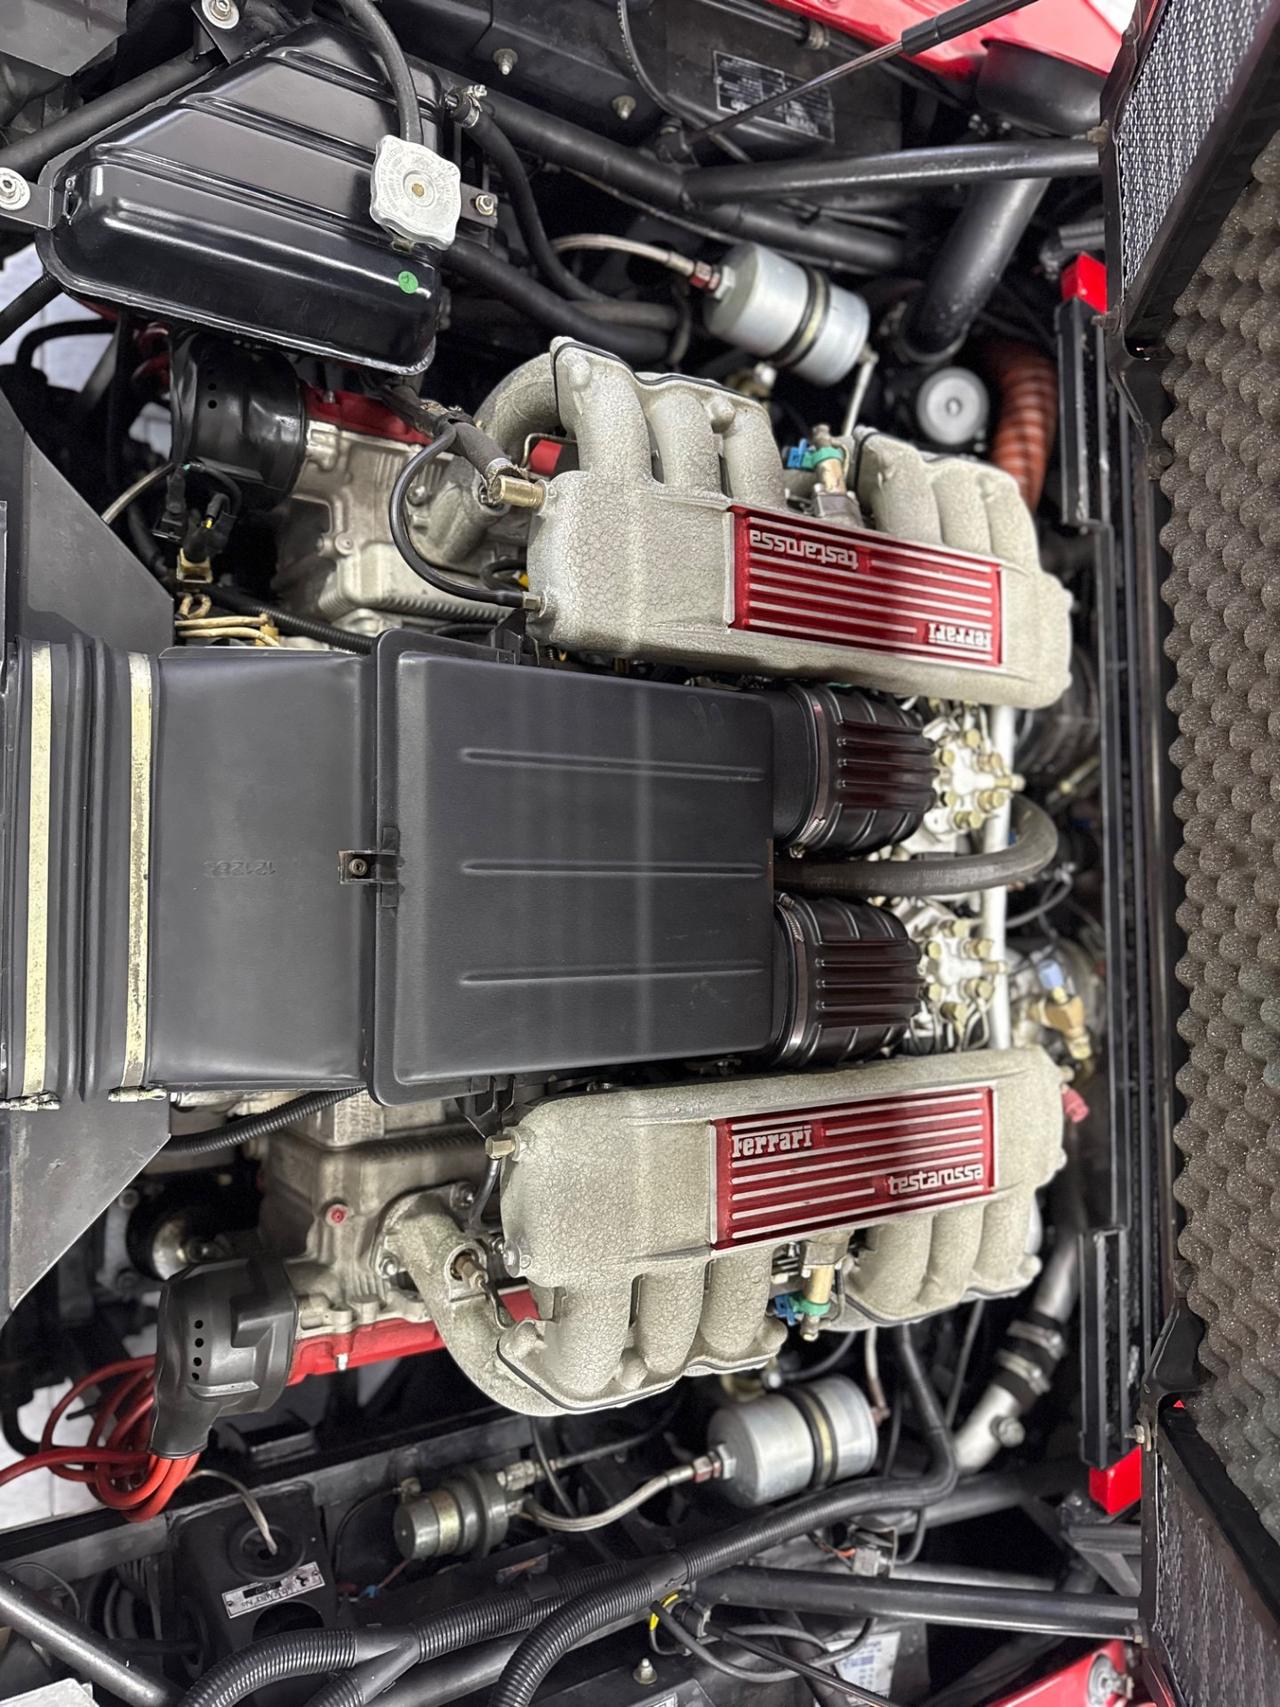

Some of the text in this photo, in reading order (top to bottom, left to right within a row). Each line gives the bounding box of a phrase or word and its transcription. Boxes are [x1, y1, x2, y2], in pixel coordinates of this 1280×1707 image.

[749, 529, 859, 570] testarossa
[928, 623, 992, 652] Ferrari
[731, 1125, 812, 1158] Ferrari
[887, 1164, 984, 1195] testarossa
